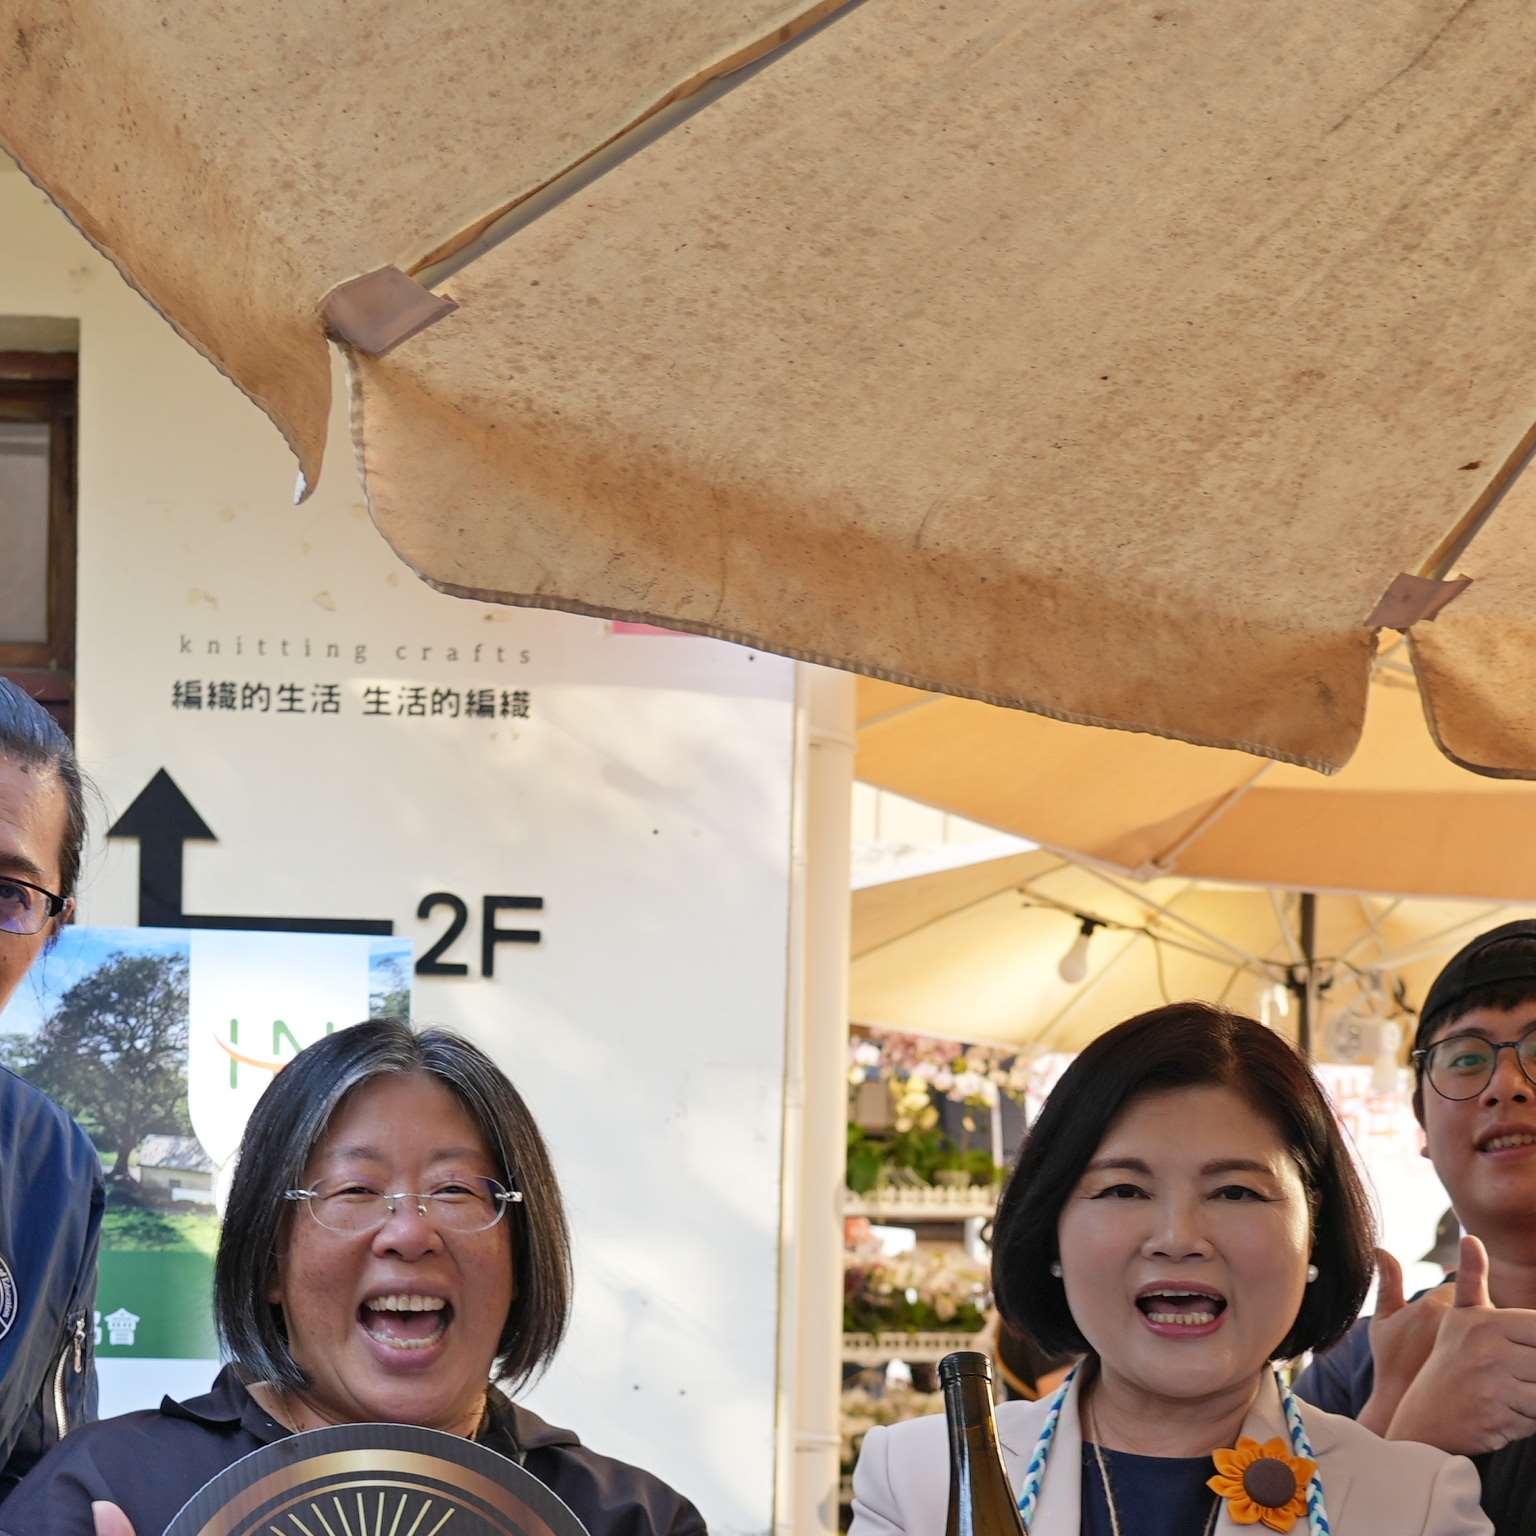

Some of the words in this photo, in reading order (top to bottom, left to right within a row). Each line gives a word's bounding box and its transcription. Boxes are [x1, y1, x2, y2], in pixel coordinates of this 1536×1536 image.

[179, 634, 369, 664] knitting
[395, 643, 534, 665] crafts
[172, 680, 342, 715] 編織的生活
[362, 684, 532, 720] 生活的編織
[414, 892, 545, 978] 2F
